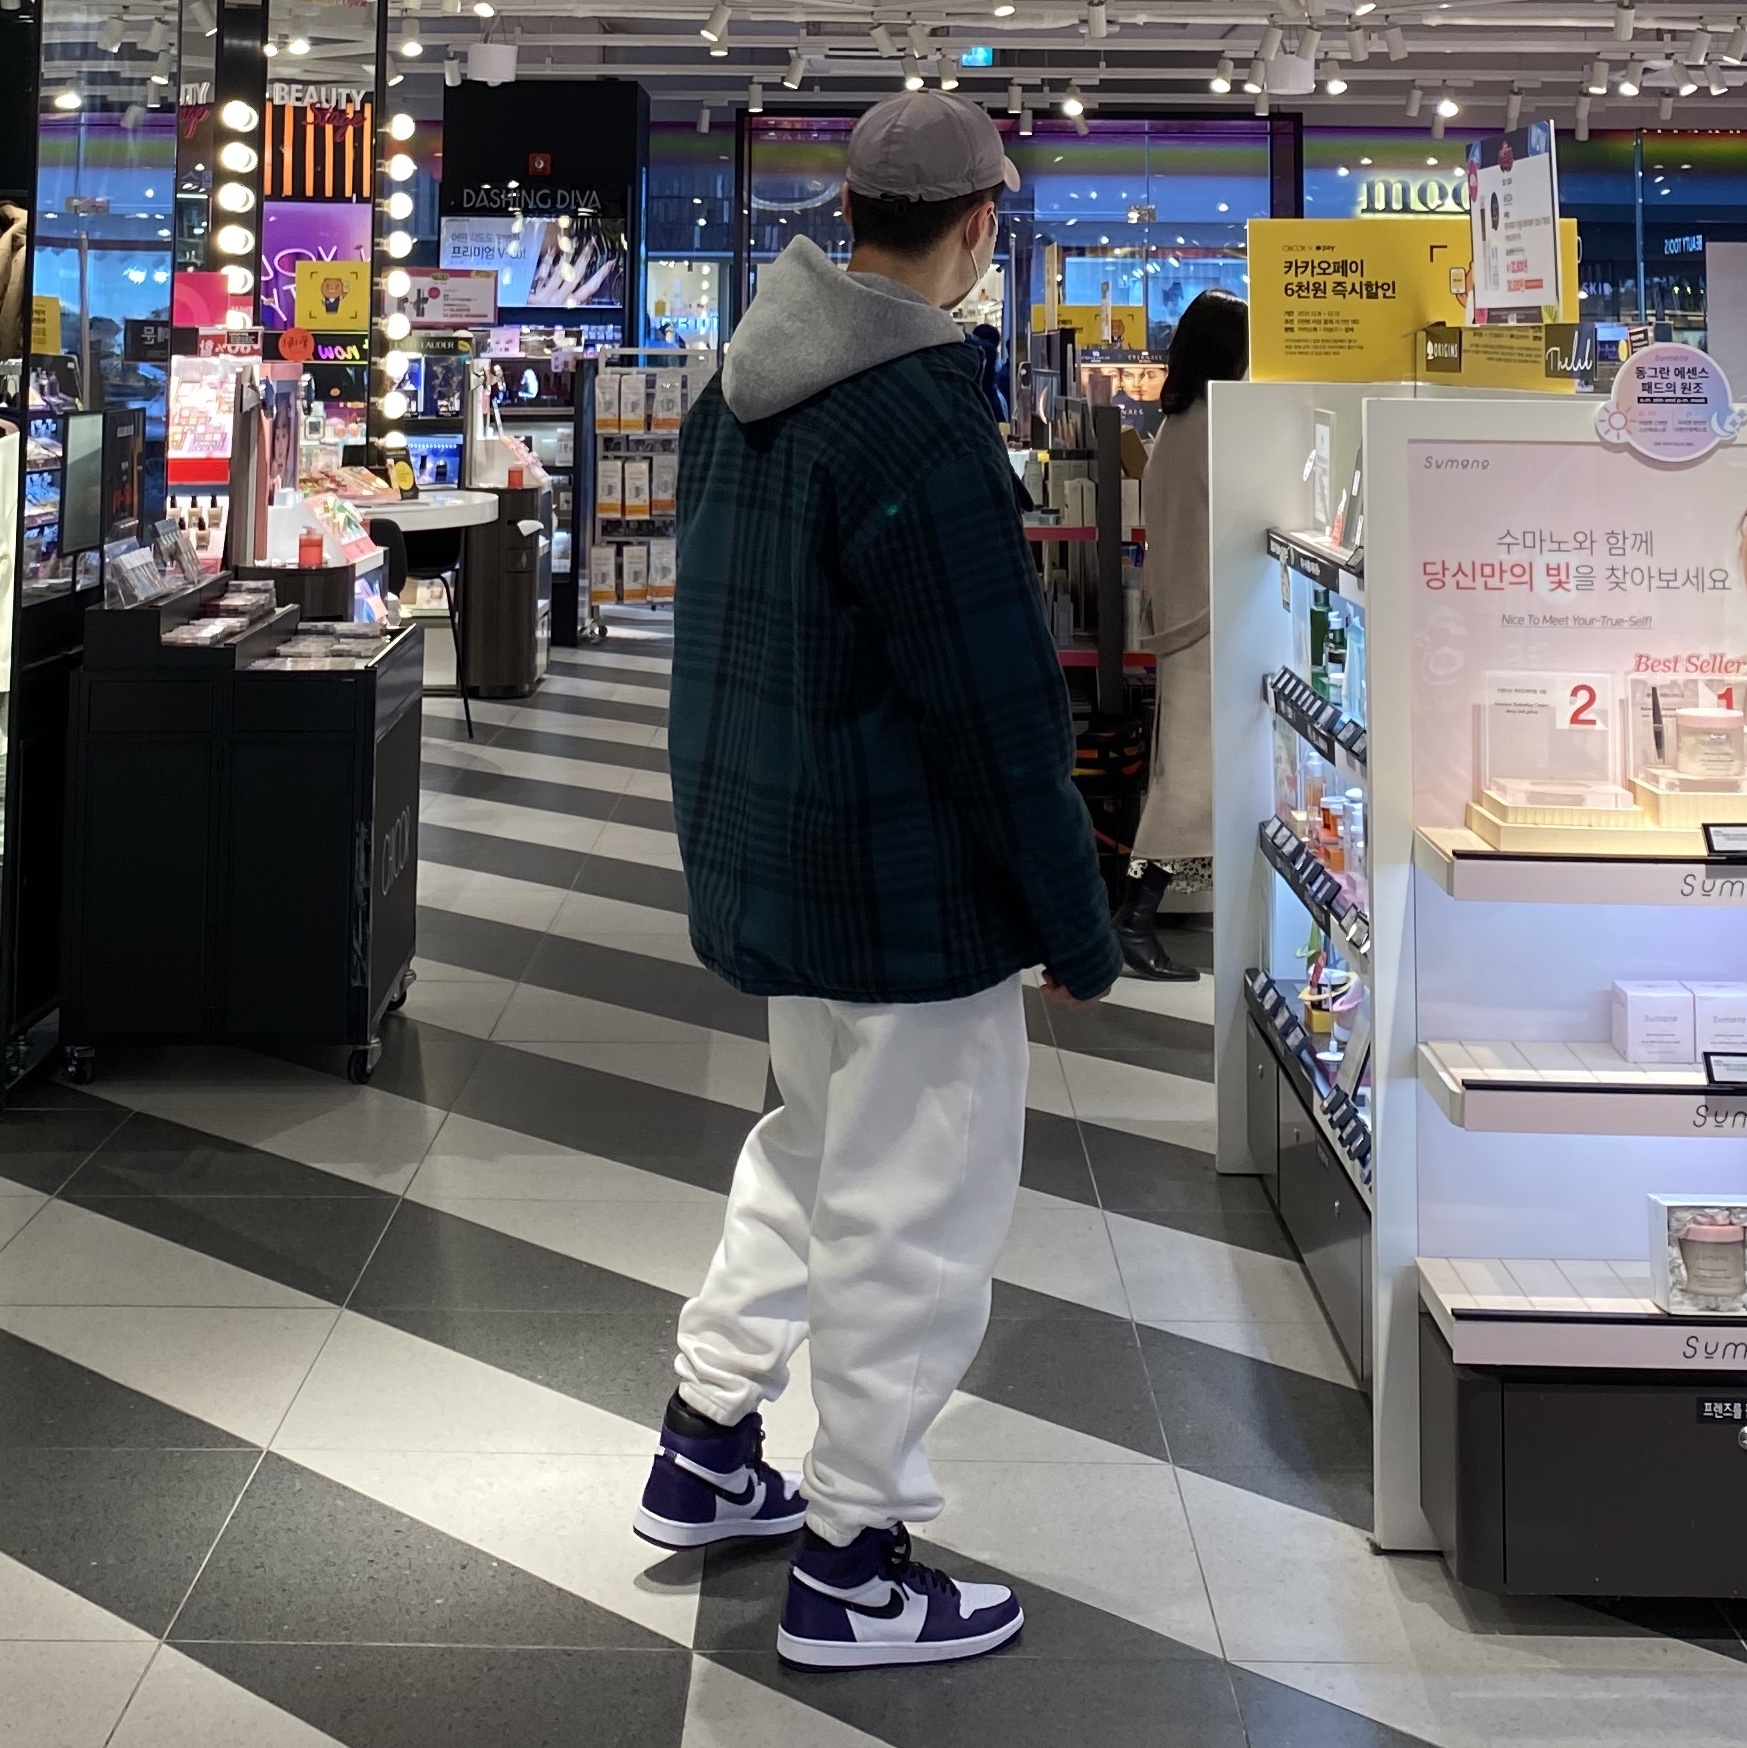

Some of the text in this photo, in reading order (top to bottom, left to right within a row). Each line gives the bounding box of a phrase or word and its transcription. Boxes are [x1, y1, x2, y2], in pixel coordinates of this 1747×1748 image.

[273, 82, 366, 111] BEAUTY
[301, 102, 367, 142] Stage
[463, 188, 601, 209] DASHING DIVA
[451, 246, 495, 260] 프리미엄
[1283, 259, 1365, 278] 카카오페이
[1284, 280, 1397, 299] 6천원 즉시할인
[420, 341, 455, 349] LAUDER
[1433, 342, 1459, 358] ORIGINS
[1635, 366, 1710, 380] 동그란 에센스
[1641, 382, 1705, 395] 패드의 원조
[1423, 456, 1490, 470] Sumano
[1496, 529, 1654, 557] 수마노와 함께
[1422, 560, 1732, 593] 당신만의 빛을 찾아보세요
[1501, 614, 1525, 625] Nice
[1527, 615, 1540, 625] To
[1541, 615, 1569, 625] Meet
[1634, 653, 1746, 674] Best Seller
[1570, 684, 1596, 725] 2
[1717, 687, 1734, 710] 1
[1681, 873, 1745, 897] Sum
[1682, 1335, 1747, 1360] Sum
[1703, 1402, 1742, 1420] 프렌즈를
